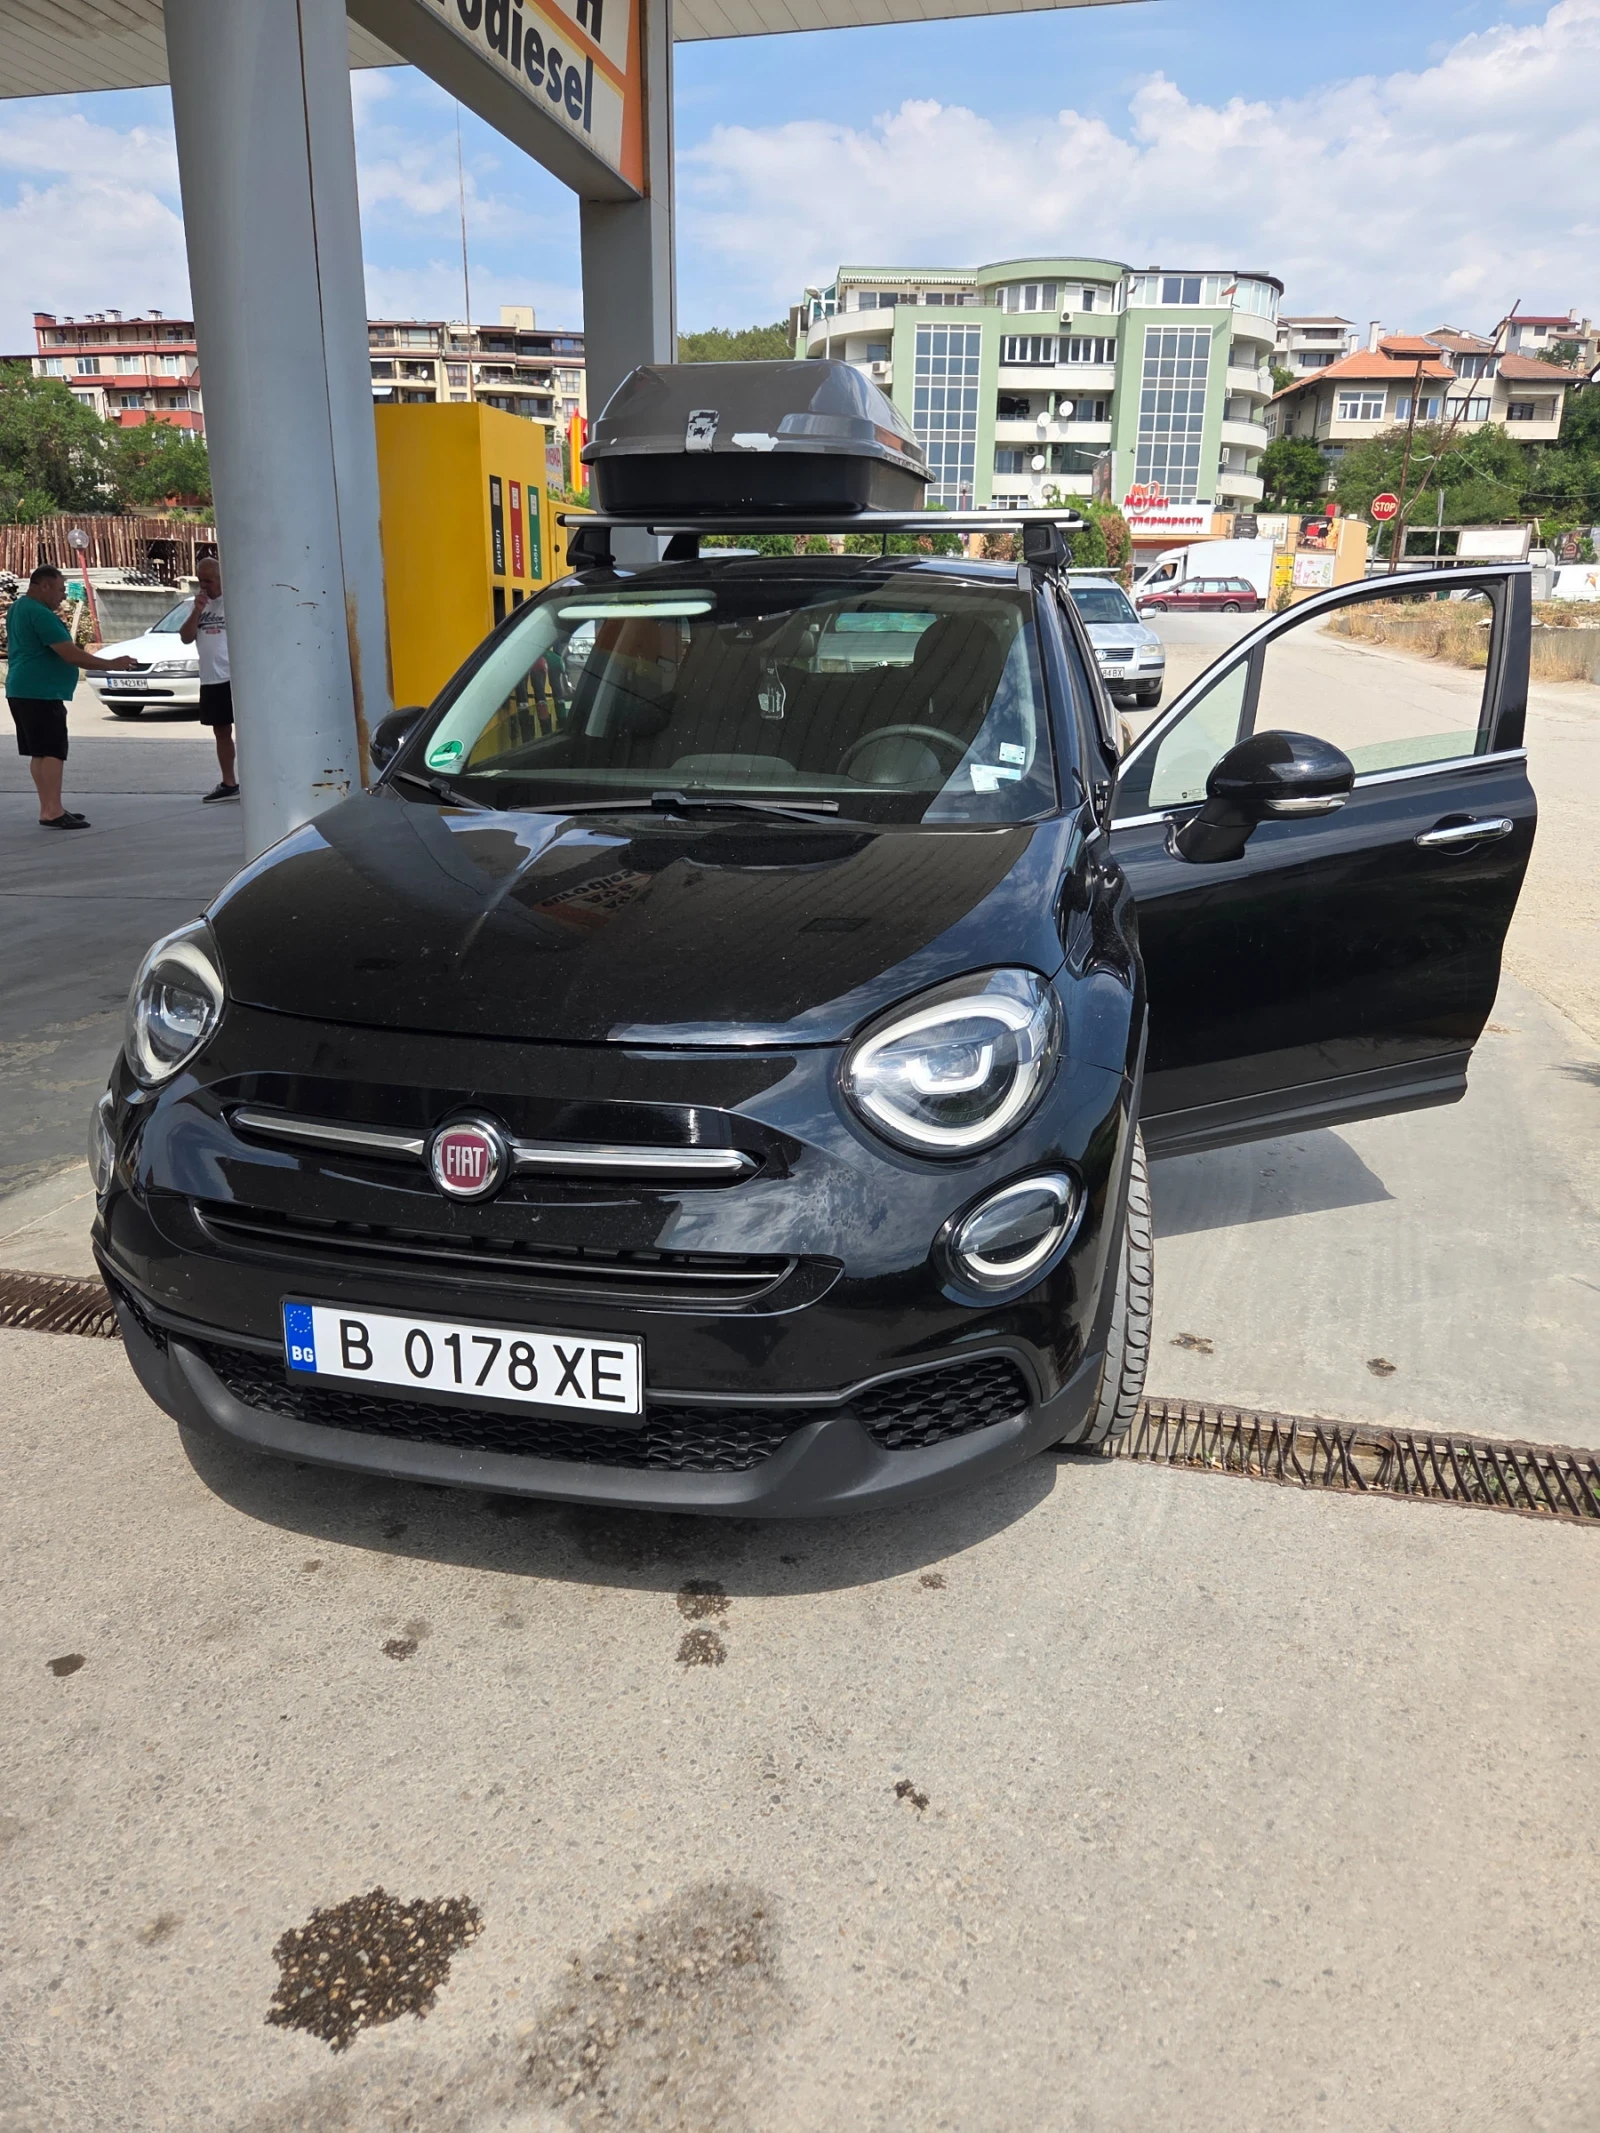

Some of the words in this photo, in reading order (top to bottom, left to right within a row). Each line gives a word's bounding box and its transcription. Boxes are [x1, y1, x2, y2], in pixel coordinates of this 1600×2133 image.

[438, 0, 594, 134] odiesel
[1374, 502, 1396, 512] STOP
[1126, 516, 1203, 529] супермаркети
[446, 1145, 485, 1177] FIAT
[291, 1345, 314, 1363] BG
[339, 1318, 373, 1371] B
[405, 1328, 539, 1392] 0178
[553, 1344, 626, 1403] XE
